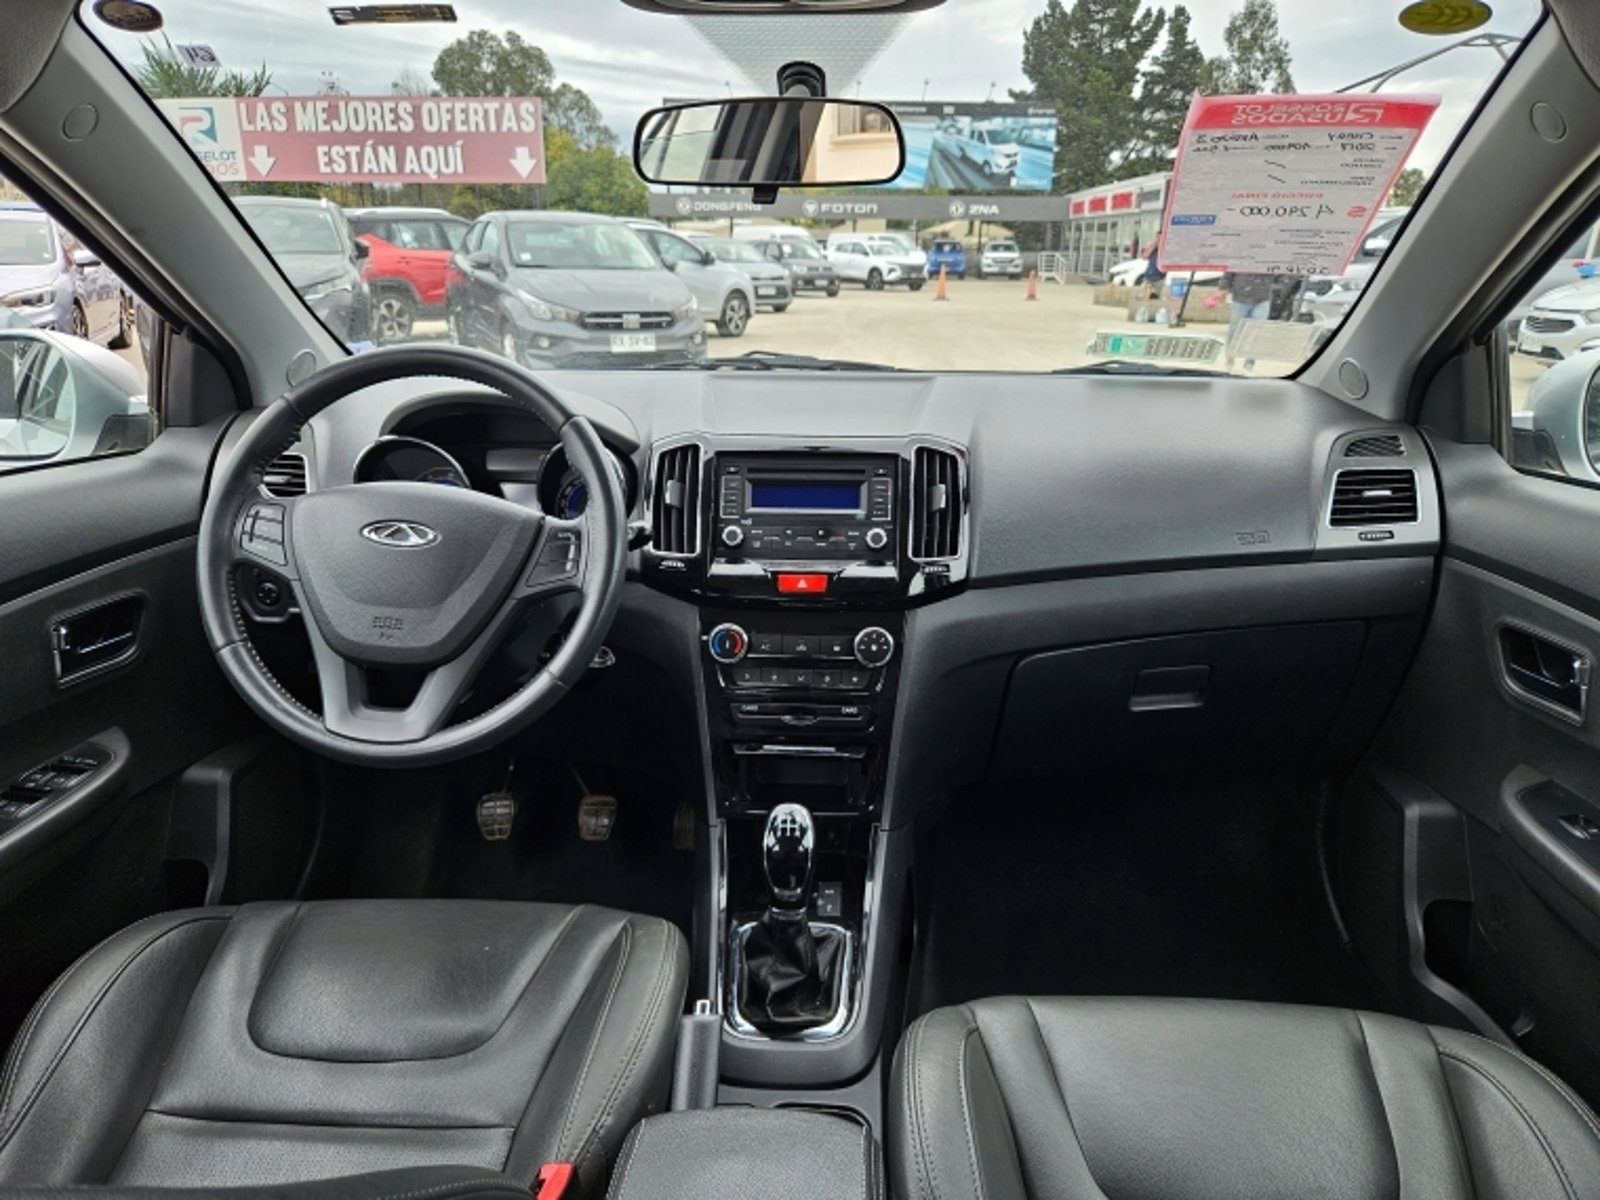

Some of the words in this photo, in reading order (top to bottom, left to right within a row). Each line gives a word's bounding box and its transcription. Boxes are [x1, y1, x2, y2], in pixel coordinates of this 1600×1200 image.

[239, 102, 288, 132] LAS
[294, 101, 415, 133] MEJORES
[421, 102, 536, 133] OFERTAS
[317, 140, 398, 174] ESTÁN
[404, 140, 464, 180] AQUÍ
[821, 203, 878, 214] FOTON
[969, 205, 999, 216] ZNA
